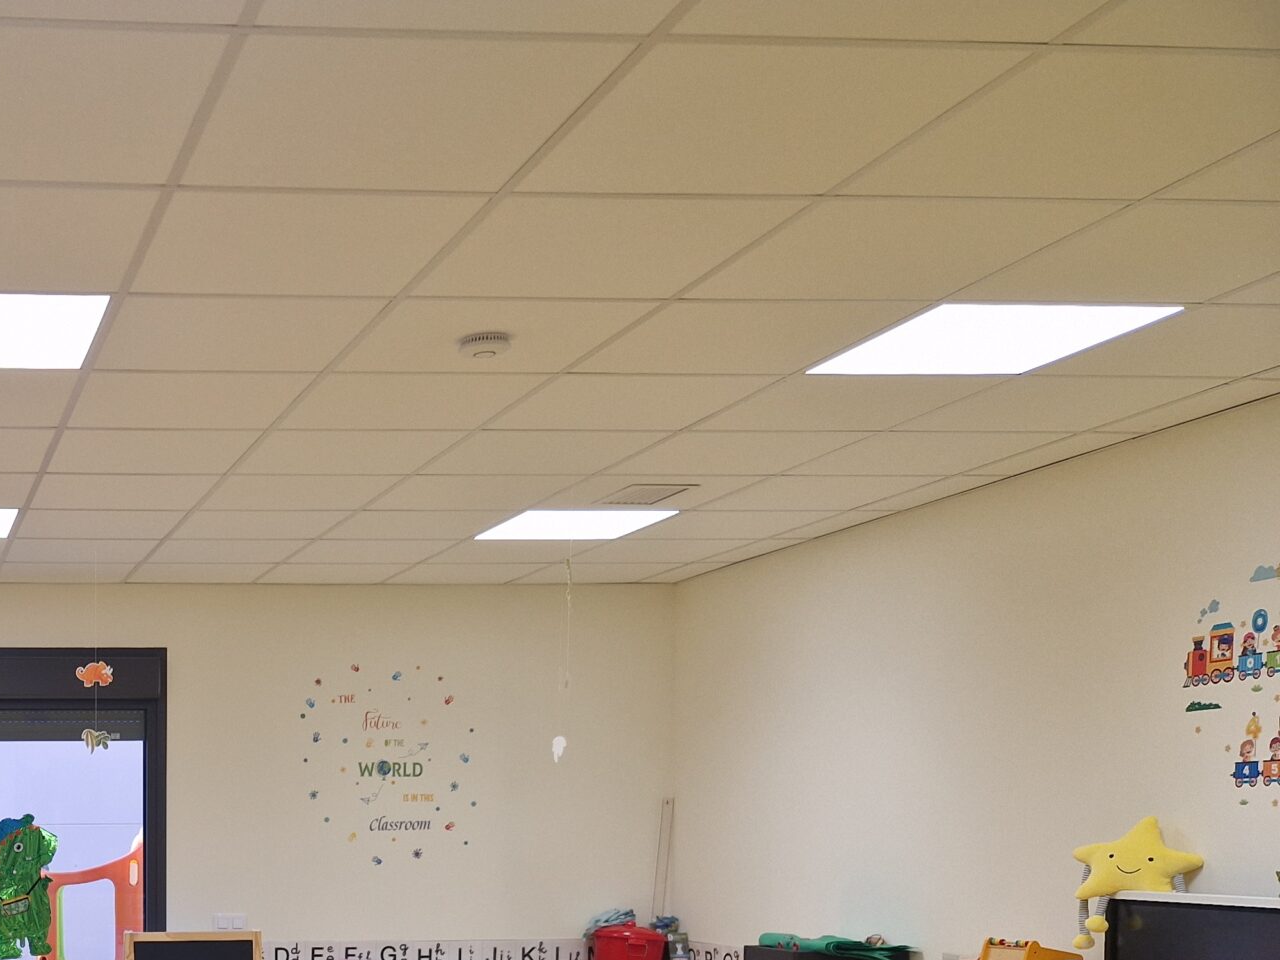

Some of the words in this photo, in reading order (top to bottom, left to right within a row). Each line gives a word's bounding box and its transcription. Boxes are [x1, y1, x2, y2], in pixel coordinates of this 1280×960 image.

[338, 694, 356, 704] THE
[362, 708, 402, 732] Future
[394, 739, 405, 747] THE
[1242, 764, 1250, 777] 4
[403, 794, 409, 802] IS
[410, 794, 419, 802] IN
[420, 794, 434, 802] THIS
[368, 815, 431, 832] Classroom
